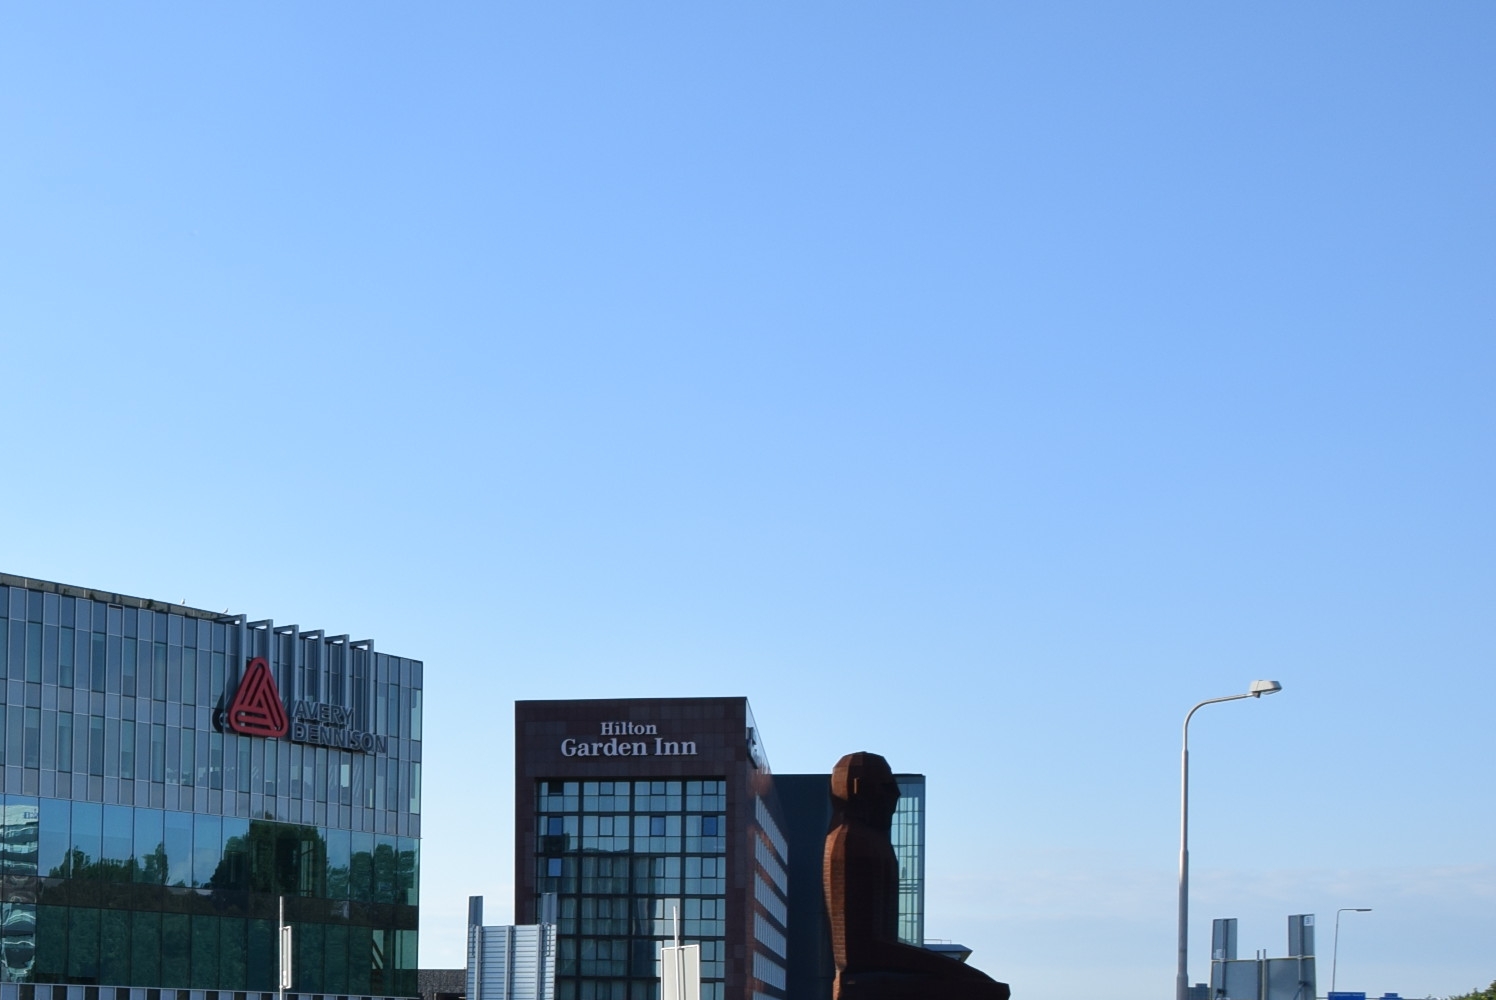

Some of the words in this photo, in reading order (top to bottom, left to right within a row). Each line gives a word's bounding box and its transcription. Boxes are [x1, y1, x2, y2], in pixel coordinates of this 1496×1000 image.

[293, 701, 353, 725] AVERY
[292, 722, 387, 753] DENNISON
[600, 721, 658, 735] Hilton
[561, 738, 648, 756] Garden
[653, 737, 698, 755] Inn
